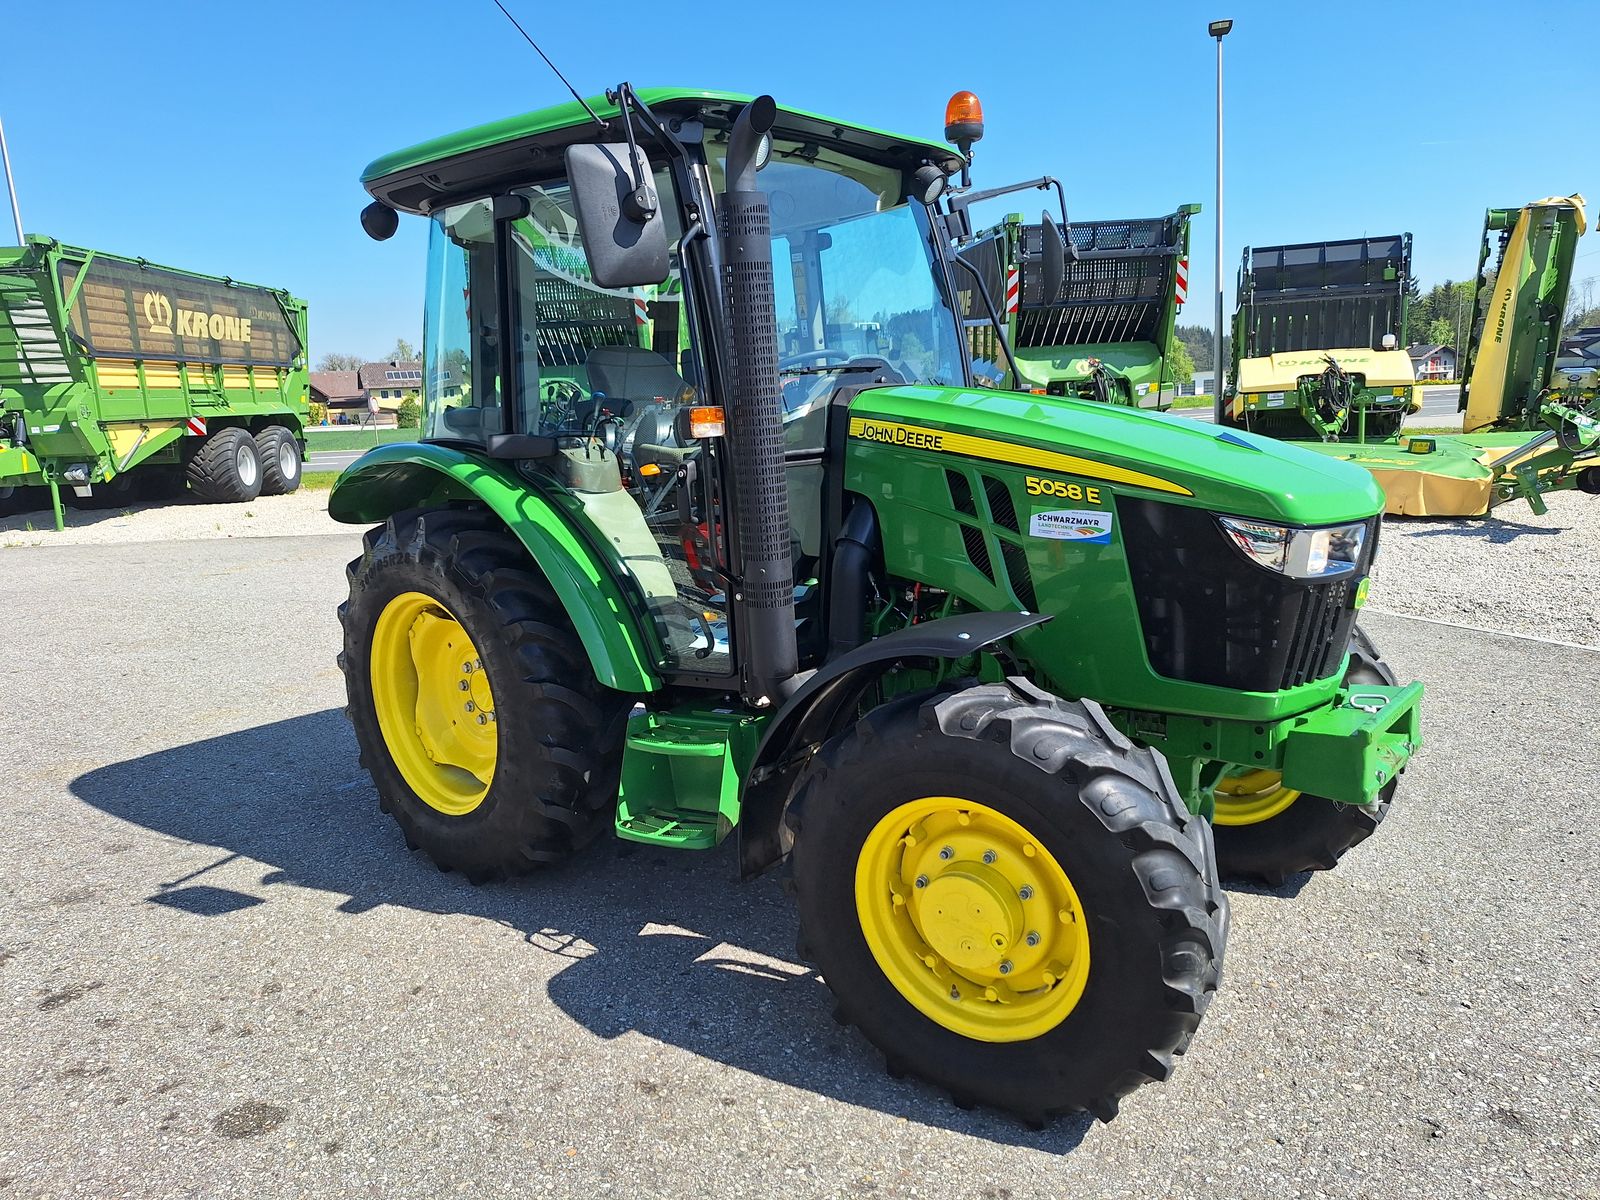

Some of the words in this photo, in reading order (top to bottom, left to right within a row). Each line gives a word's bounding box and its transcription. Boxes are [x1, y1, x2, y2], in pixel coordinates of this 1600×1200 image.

[176, 308, 252, 343] KRONE
[1494, 302, 1508, 344] KRONE
[859, 422, 894, 441] JOHN
[896, 427, 944, 449] DEERE
[1025, 475, 1083, 501] 5058
[1085, 486, 1102, 505] E
[1037, 513, 1100, 527] SCHWARZMAYR
[1037, 521, 1074, 531] LANDTECHNIK
